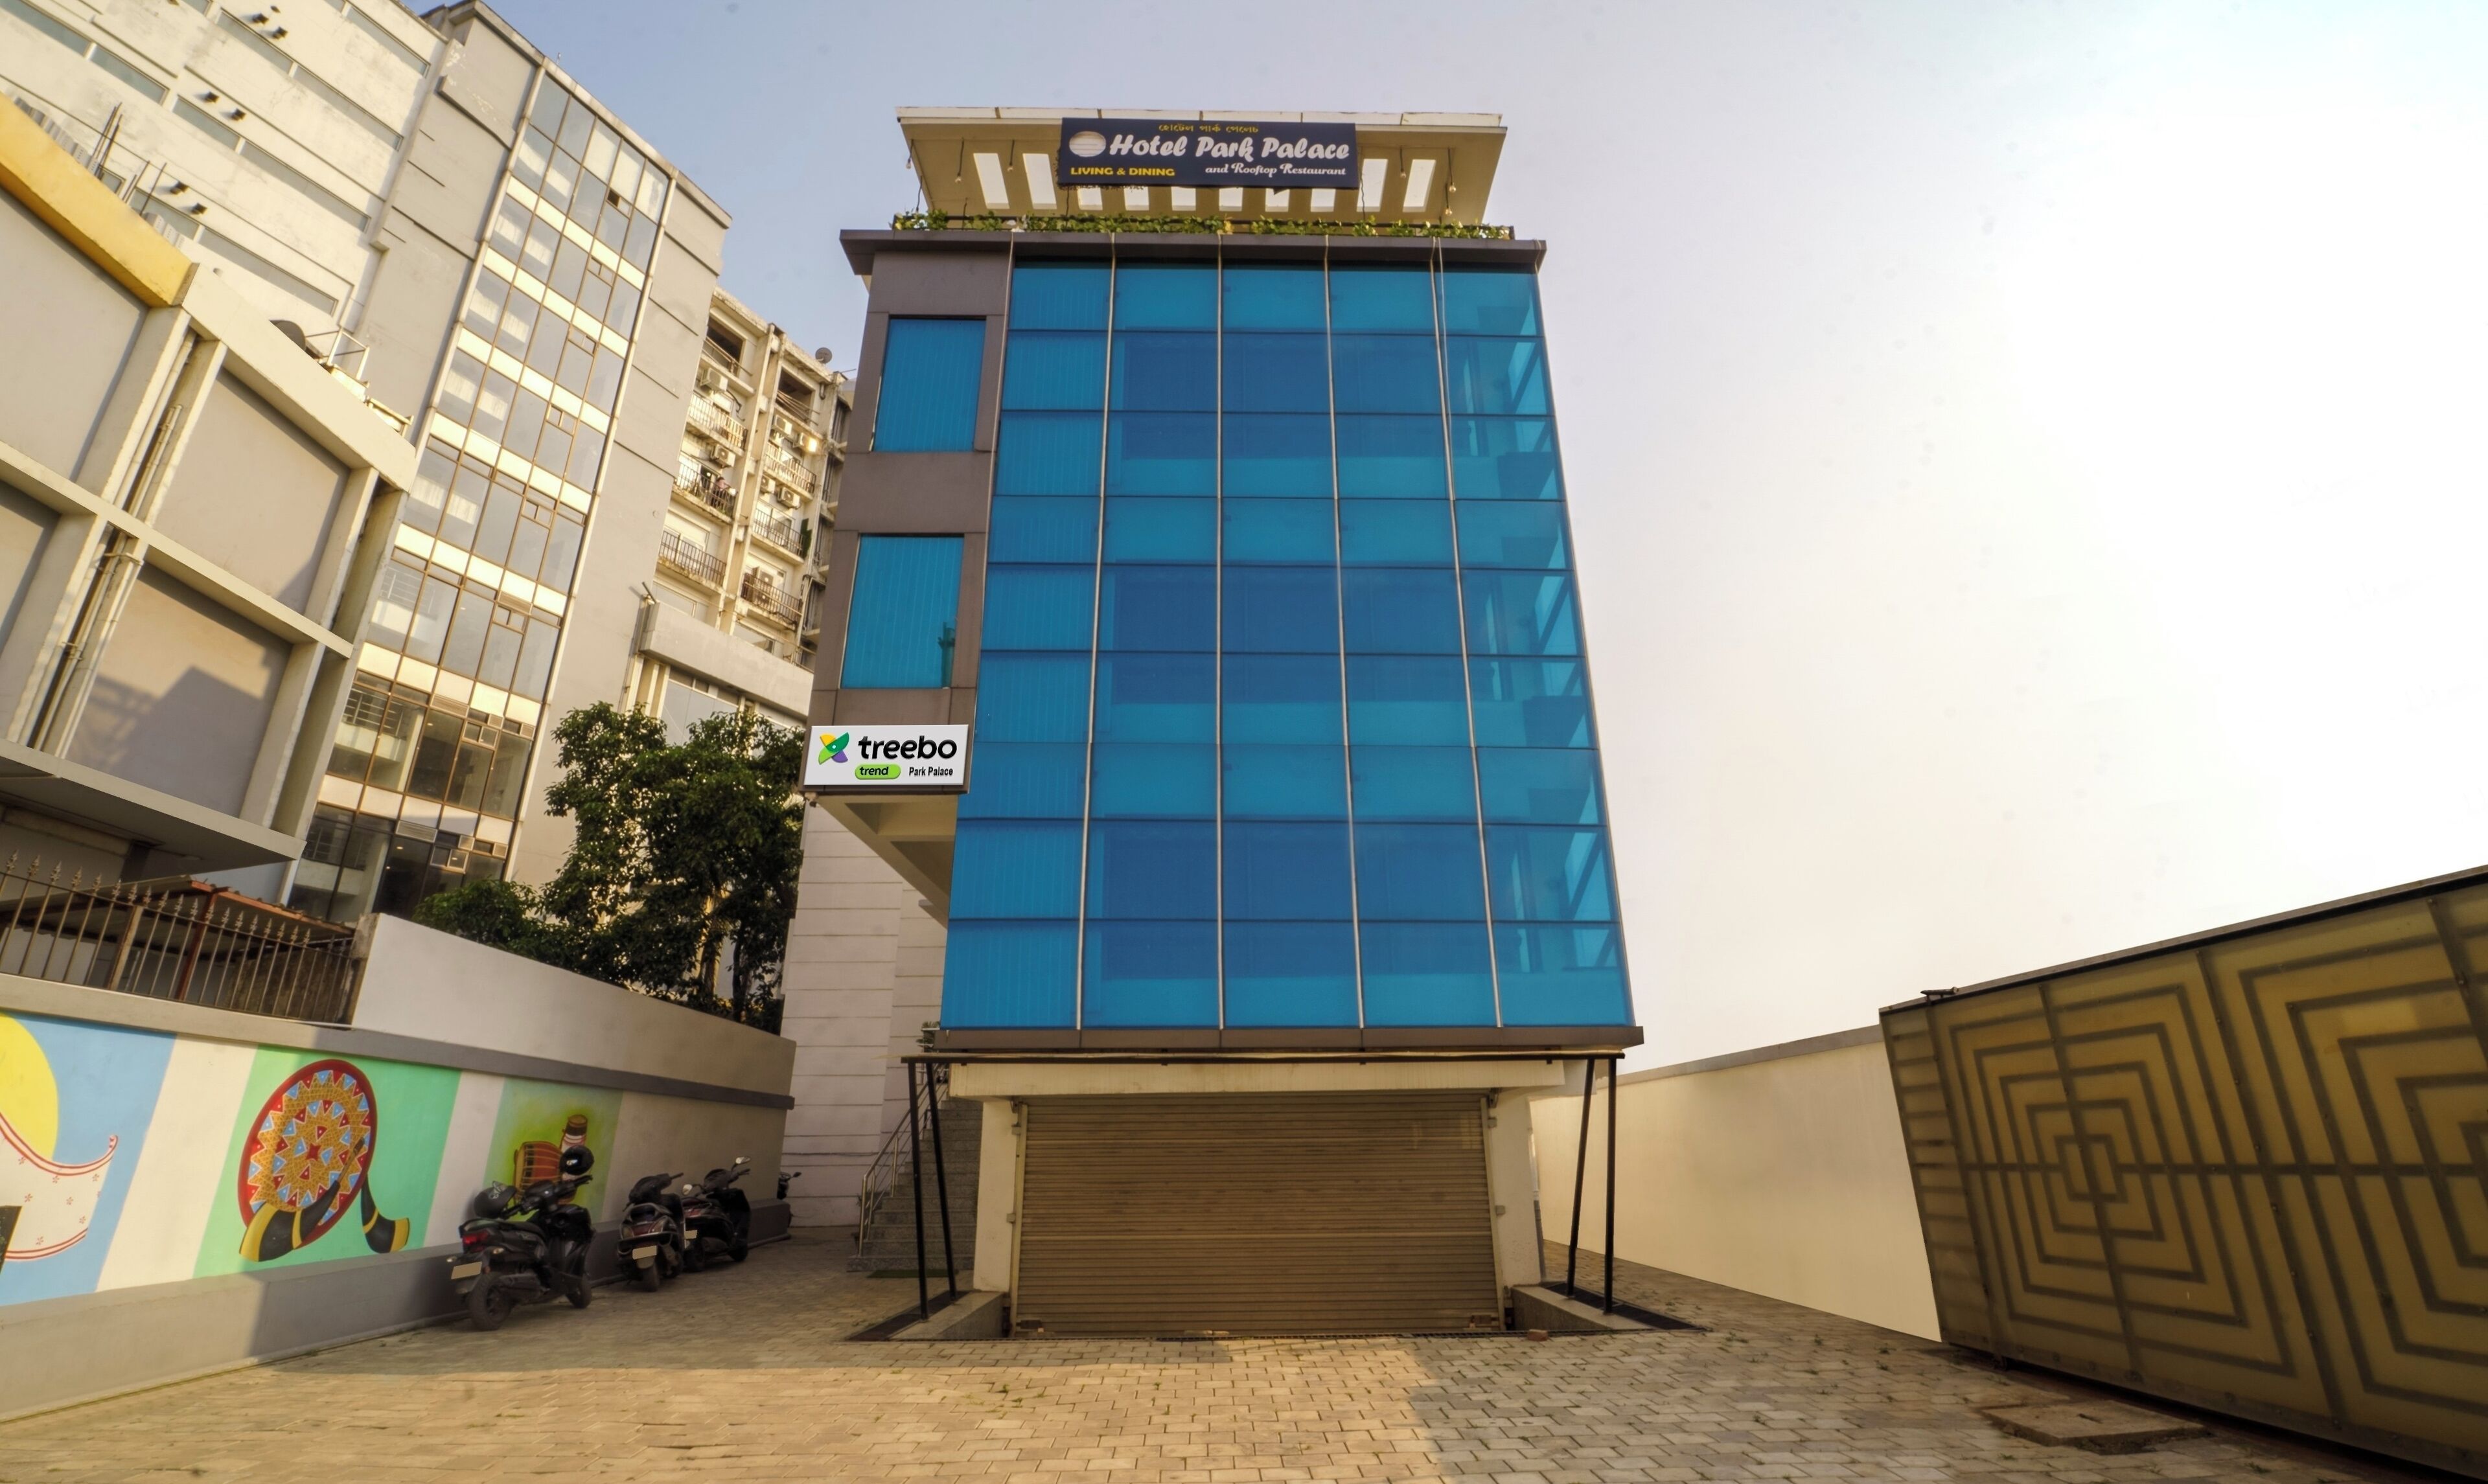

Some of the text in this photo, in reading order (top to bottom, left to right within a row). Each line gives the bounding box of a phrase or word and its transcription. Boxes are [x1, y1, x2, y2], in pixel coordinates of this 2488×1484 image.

[1109, 133, 1350, 162] Hotel Park Palace
[1070, 166, 1175, 177] LIVING & DINING
[1205, 163, 1346, 178] and Rooftop Restaurant
[858, 735, 957, 759] treebo
[859, 766, 889, 775] trend
[908, 766, 953, 777] Park Palace
